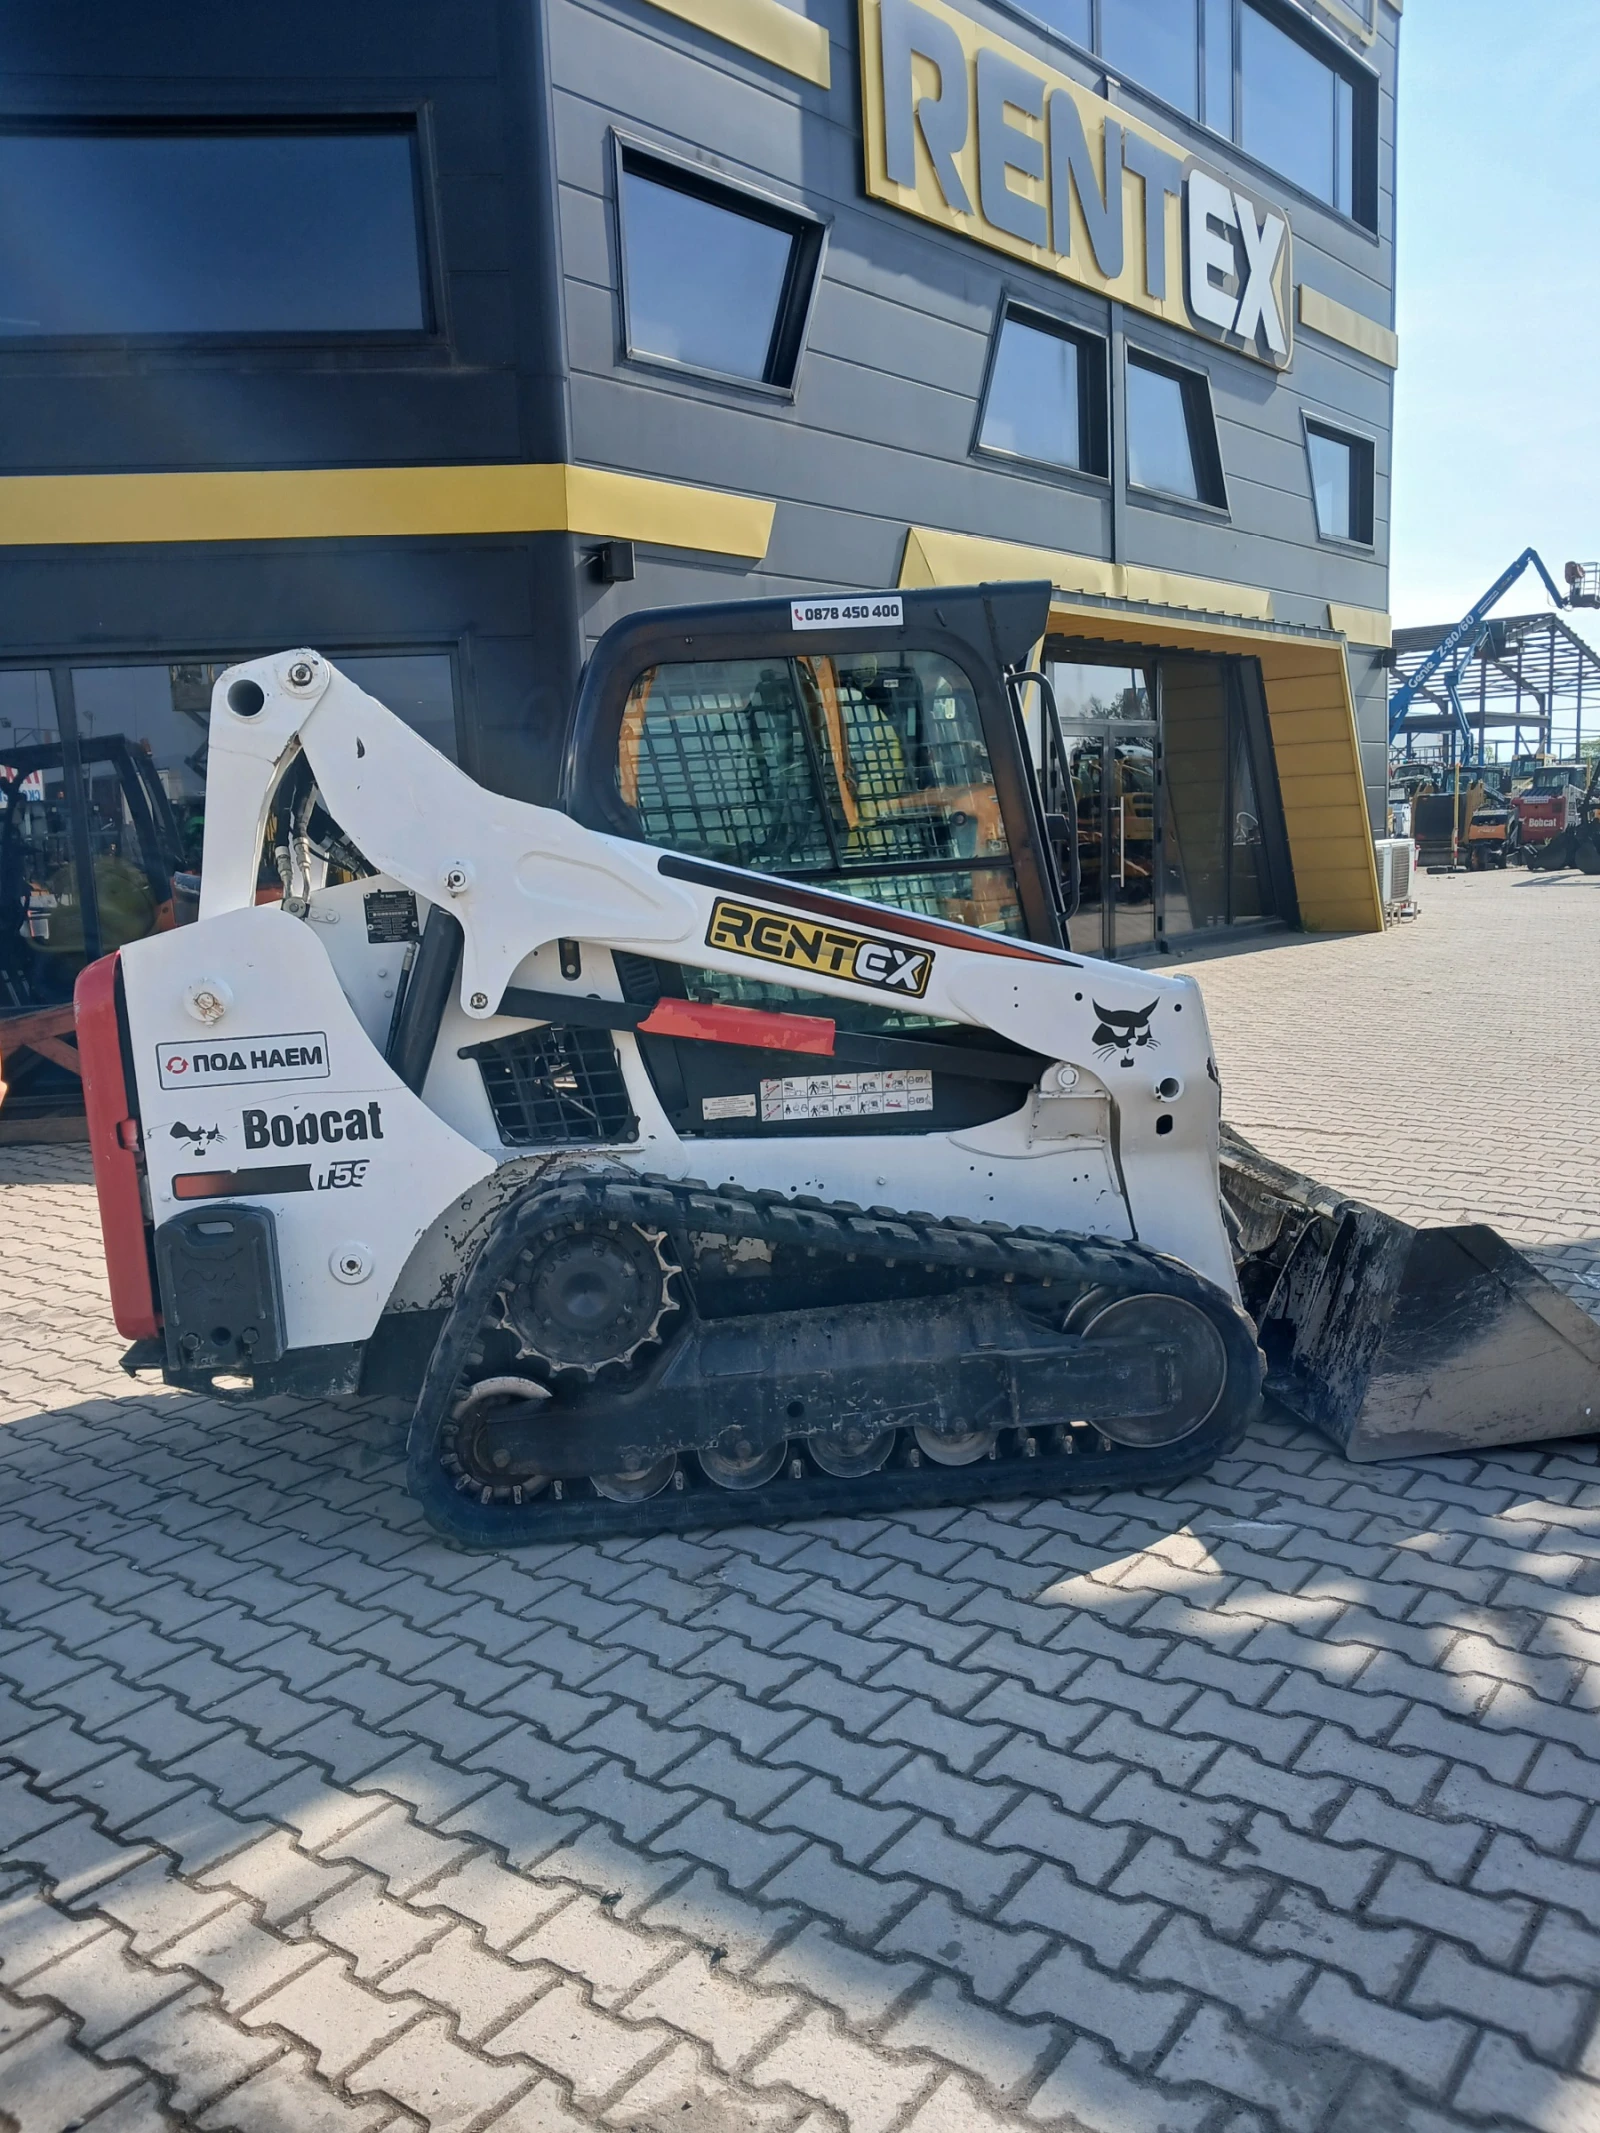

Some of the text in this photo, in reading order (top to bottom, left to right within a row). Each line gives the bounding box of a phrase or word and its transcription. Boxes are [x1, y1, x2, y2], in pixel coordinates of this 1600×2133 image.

[880, 0, 1287, 355] RENTEX
[805, 604, 899, 621] 0878 450 400
[1408, 614, 1474, 688] Genie Z-80/60
[1528, 818, 1557, 827] Bobcat
[714, 906, 926, 991] RENTEX
[193, 1046, 323, 1072] ПОД НАЕМ
[242, 1101, 384, 1150] Bobcat
